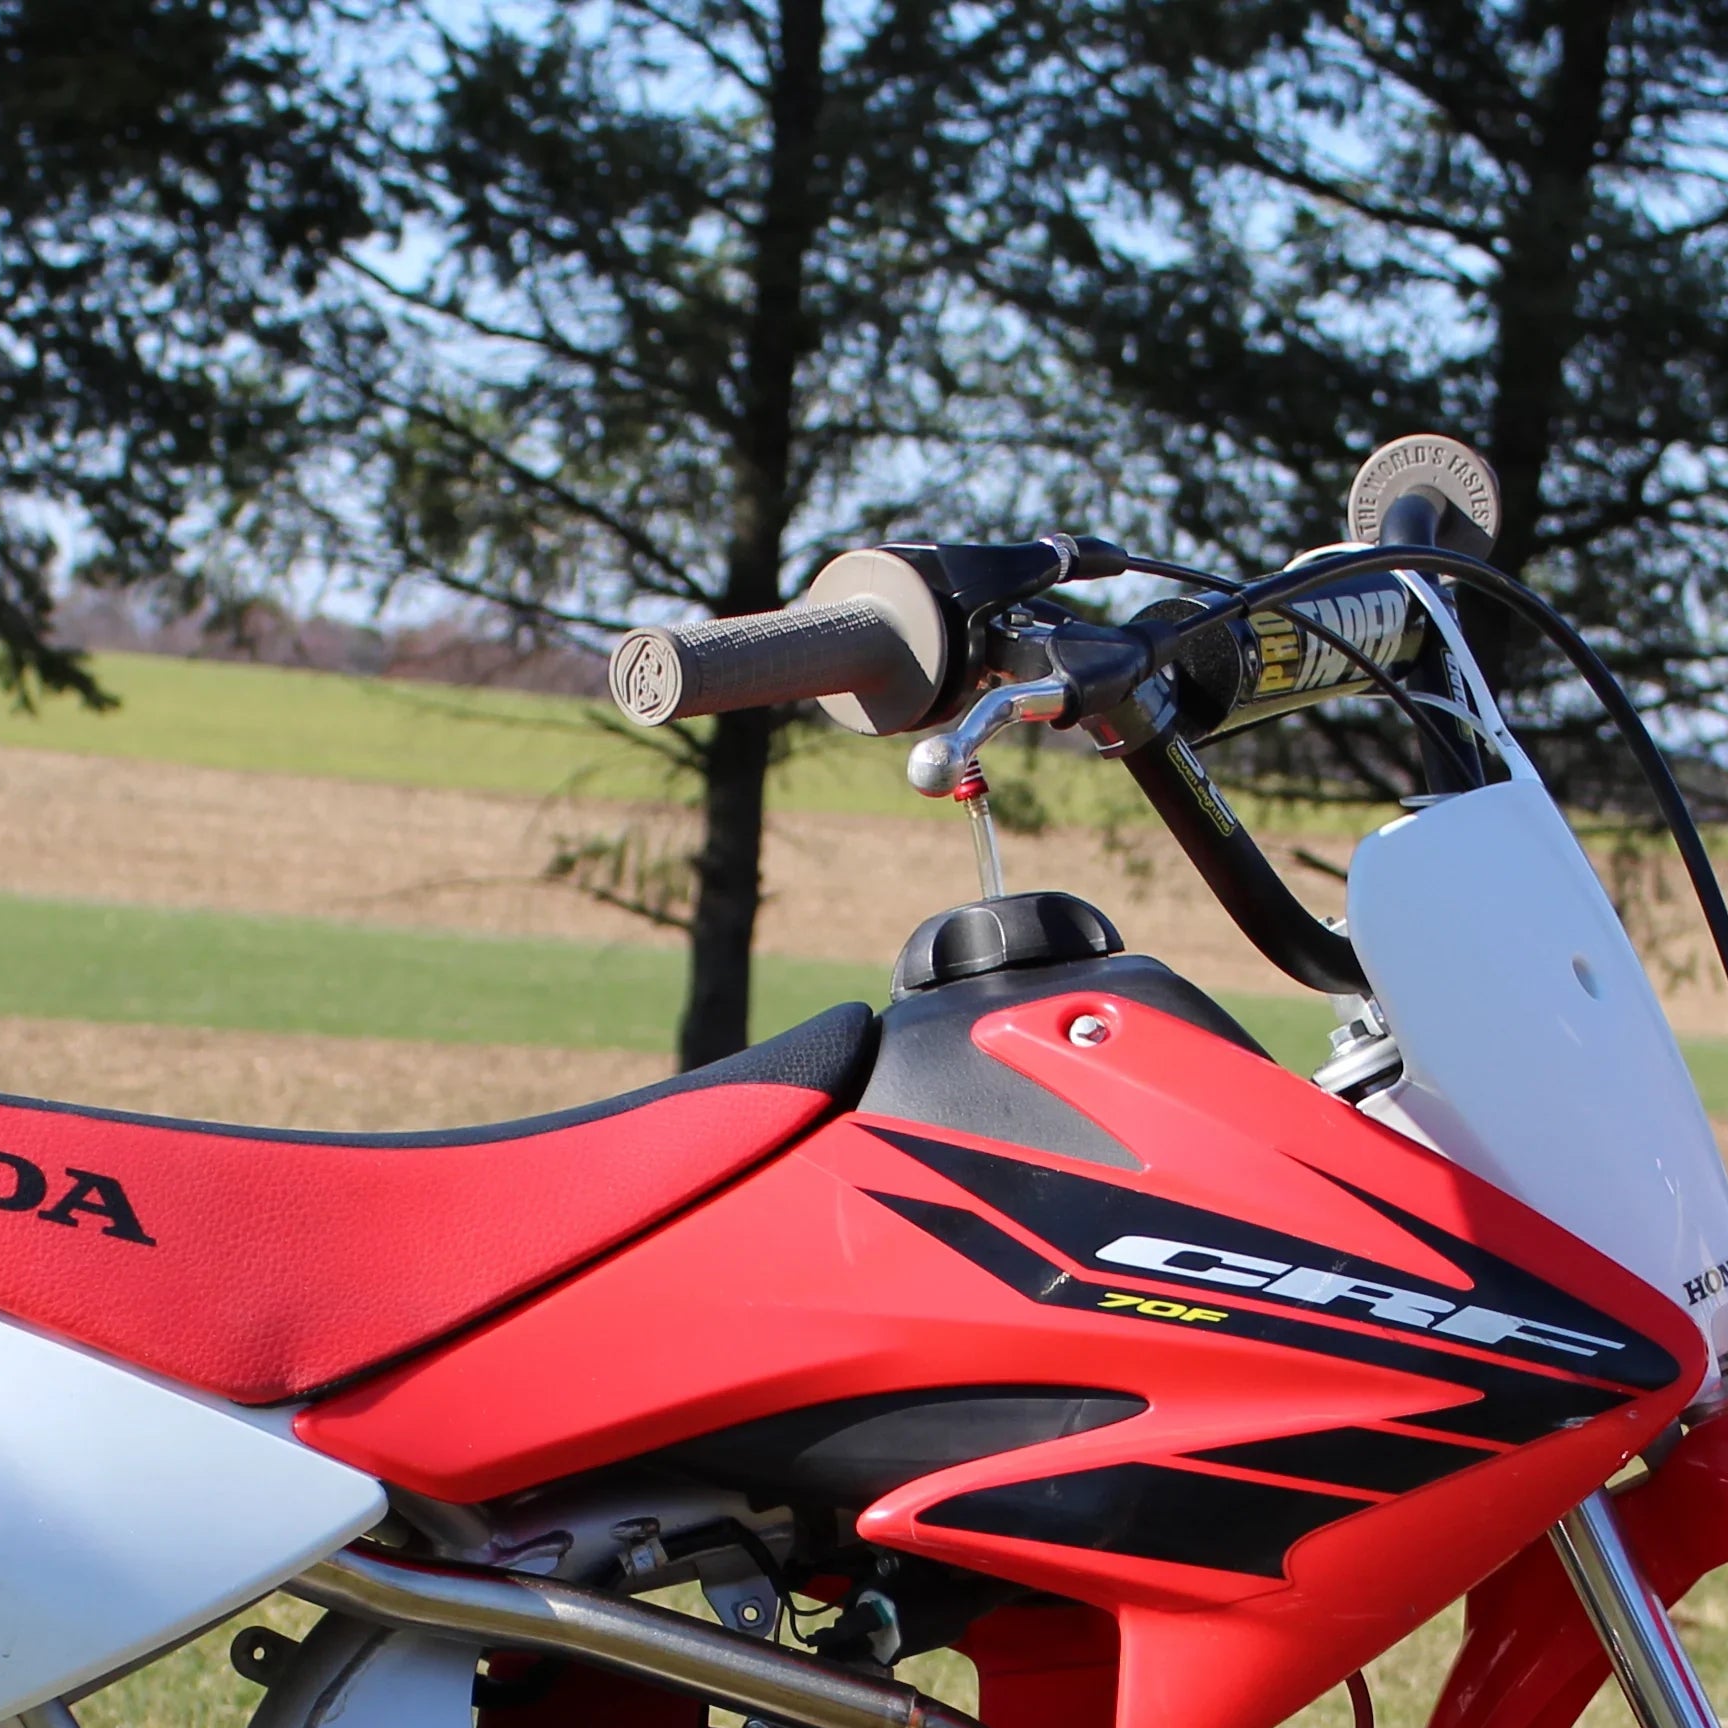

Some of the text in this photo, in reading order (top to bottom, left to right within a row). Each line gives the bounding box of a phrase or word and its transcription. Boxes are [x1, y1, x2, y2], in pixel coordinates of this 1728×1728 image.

[1358, 445, 1490, 535] THE WORLD'S FASTES
[1248, 610, 1299, 694] PRO
[1292, 589, 1407, 693] TAPER
[1095, 1235, 1627, 1357] CRF
[1096, 1292, 1229, 1324] 70F
